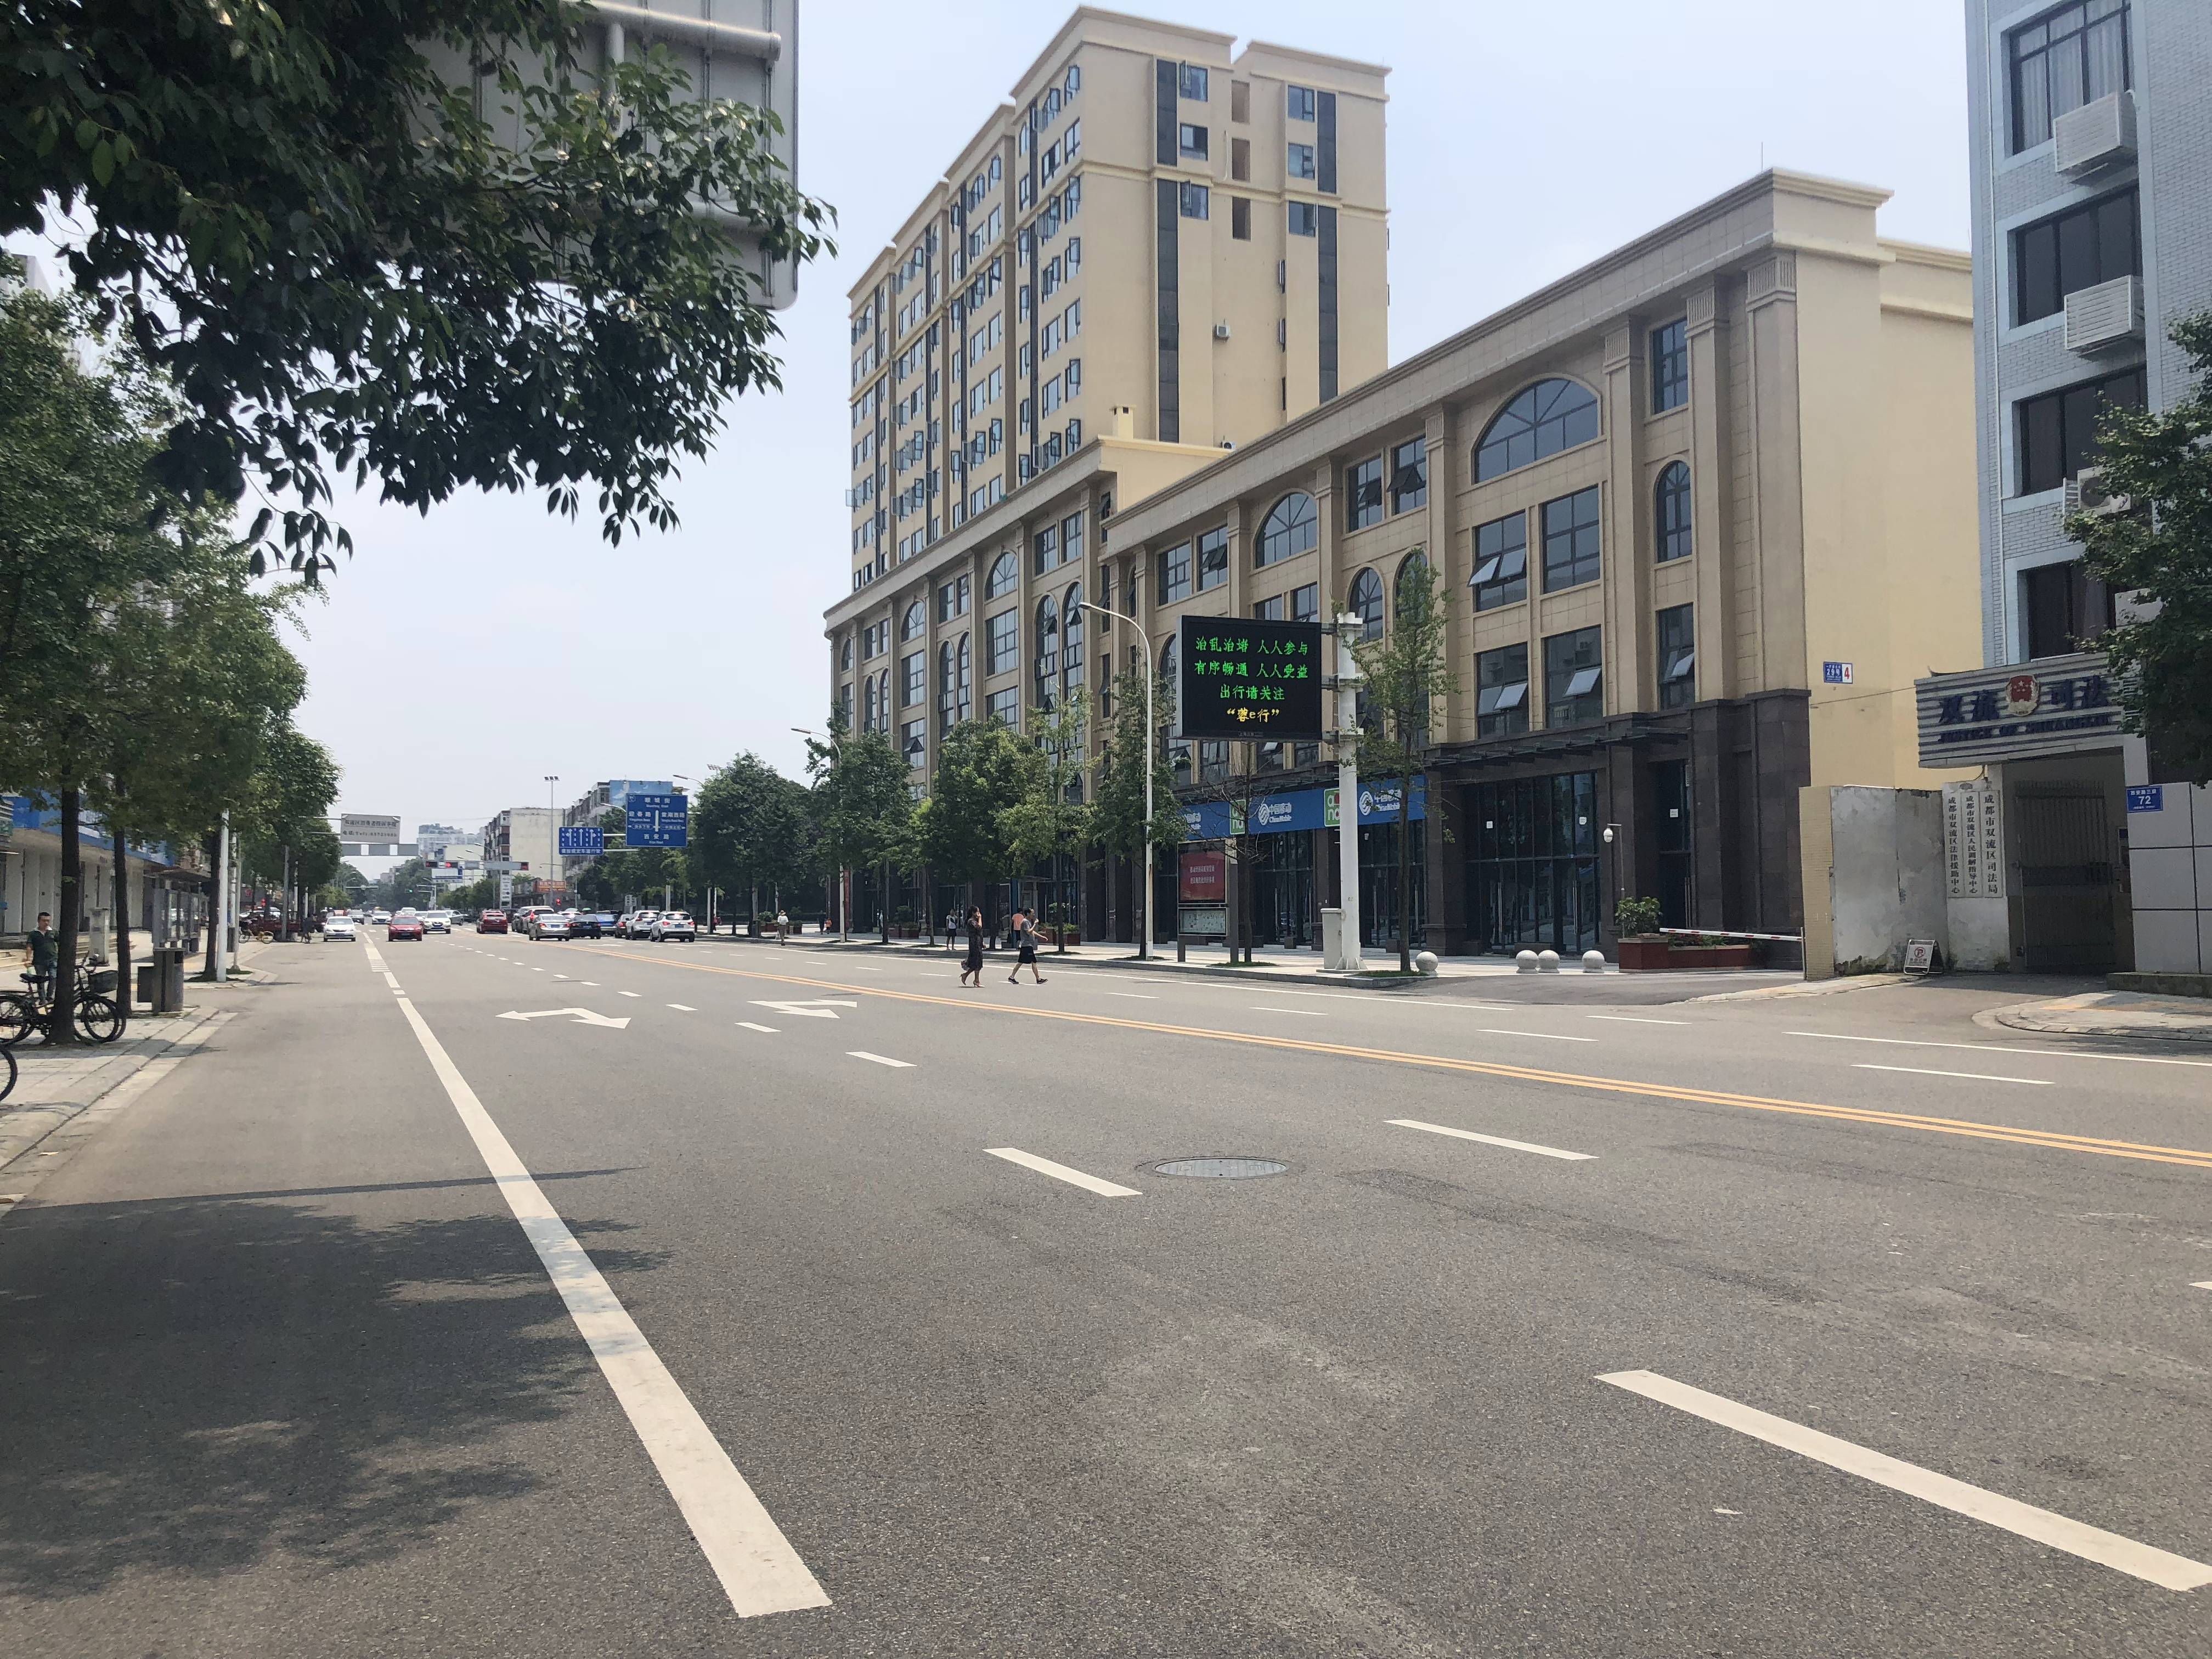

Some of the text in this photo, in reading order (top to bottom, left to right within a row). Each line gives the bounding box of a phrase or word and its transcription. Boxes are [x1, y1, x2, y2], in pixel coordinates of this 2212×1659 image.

[1195, 635, 1308, 656] 治乱治堵 人人参与
[1194, 660, 1308, 679] 有序畅通 人人受益
[1844, 667, 1850, 680] 4
[1220, 684, 1285, 701] 出行请关注
[1269, 802, 1291, 815] 中国移动
[2138, 796, 2151, 804] 72
[1948, 797, 1960, 894] 成都市双流区法律援助中心
[1966, 795, 1978, 894] 成都市双流区人民调解指导中心
[1984, 794, 1998, 894] 成都市双流区司法局
